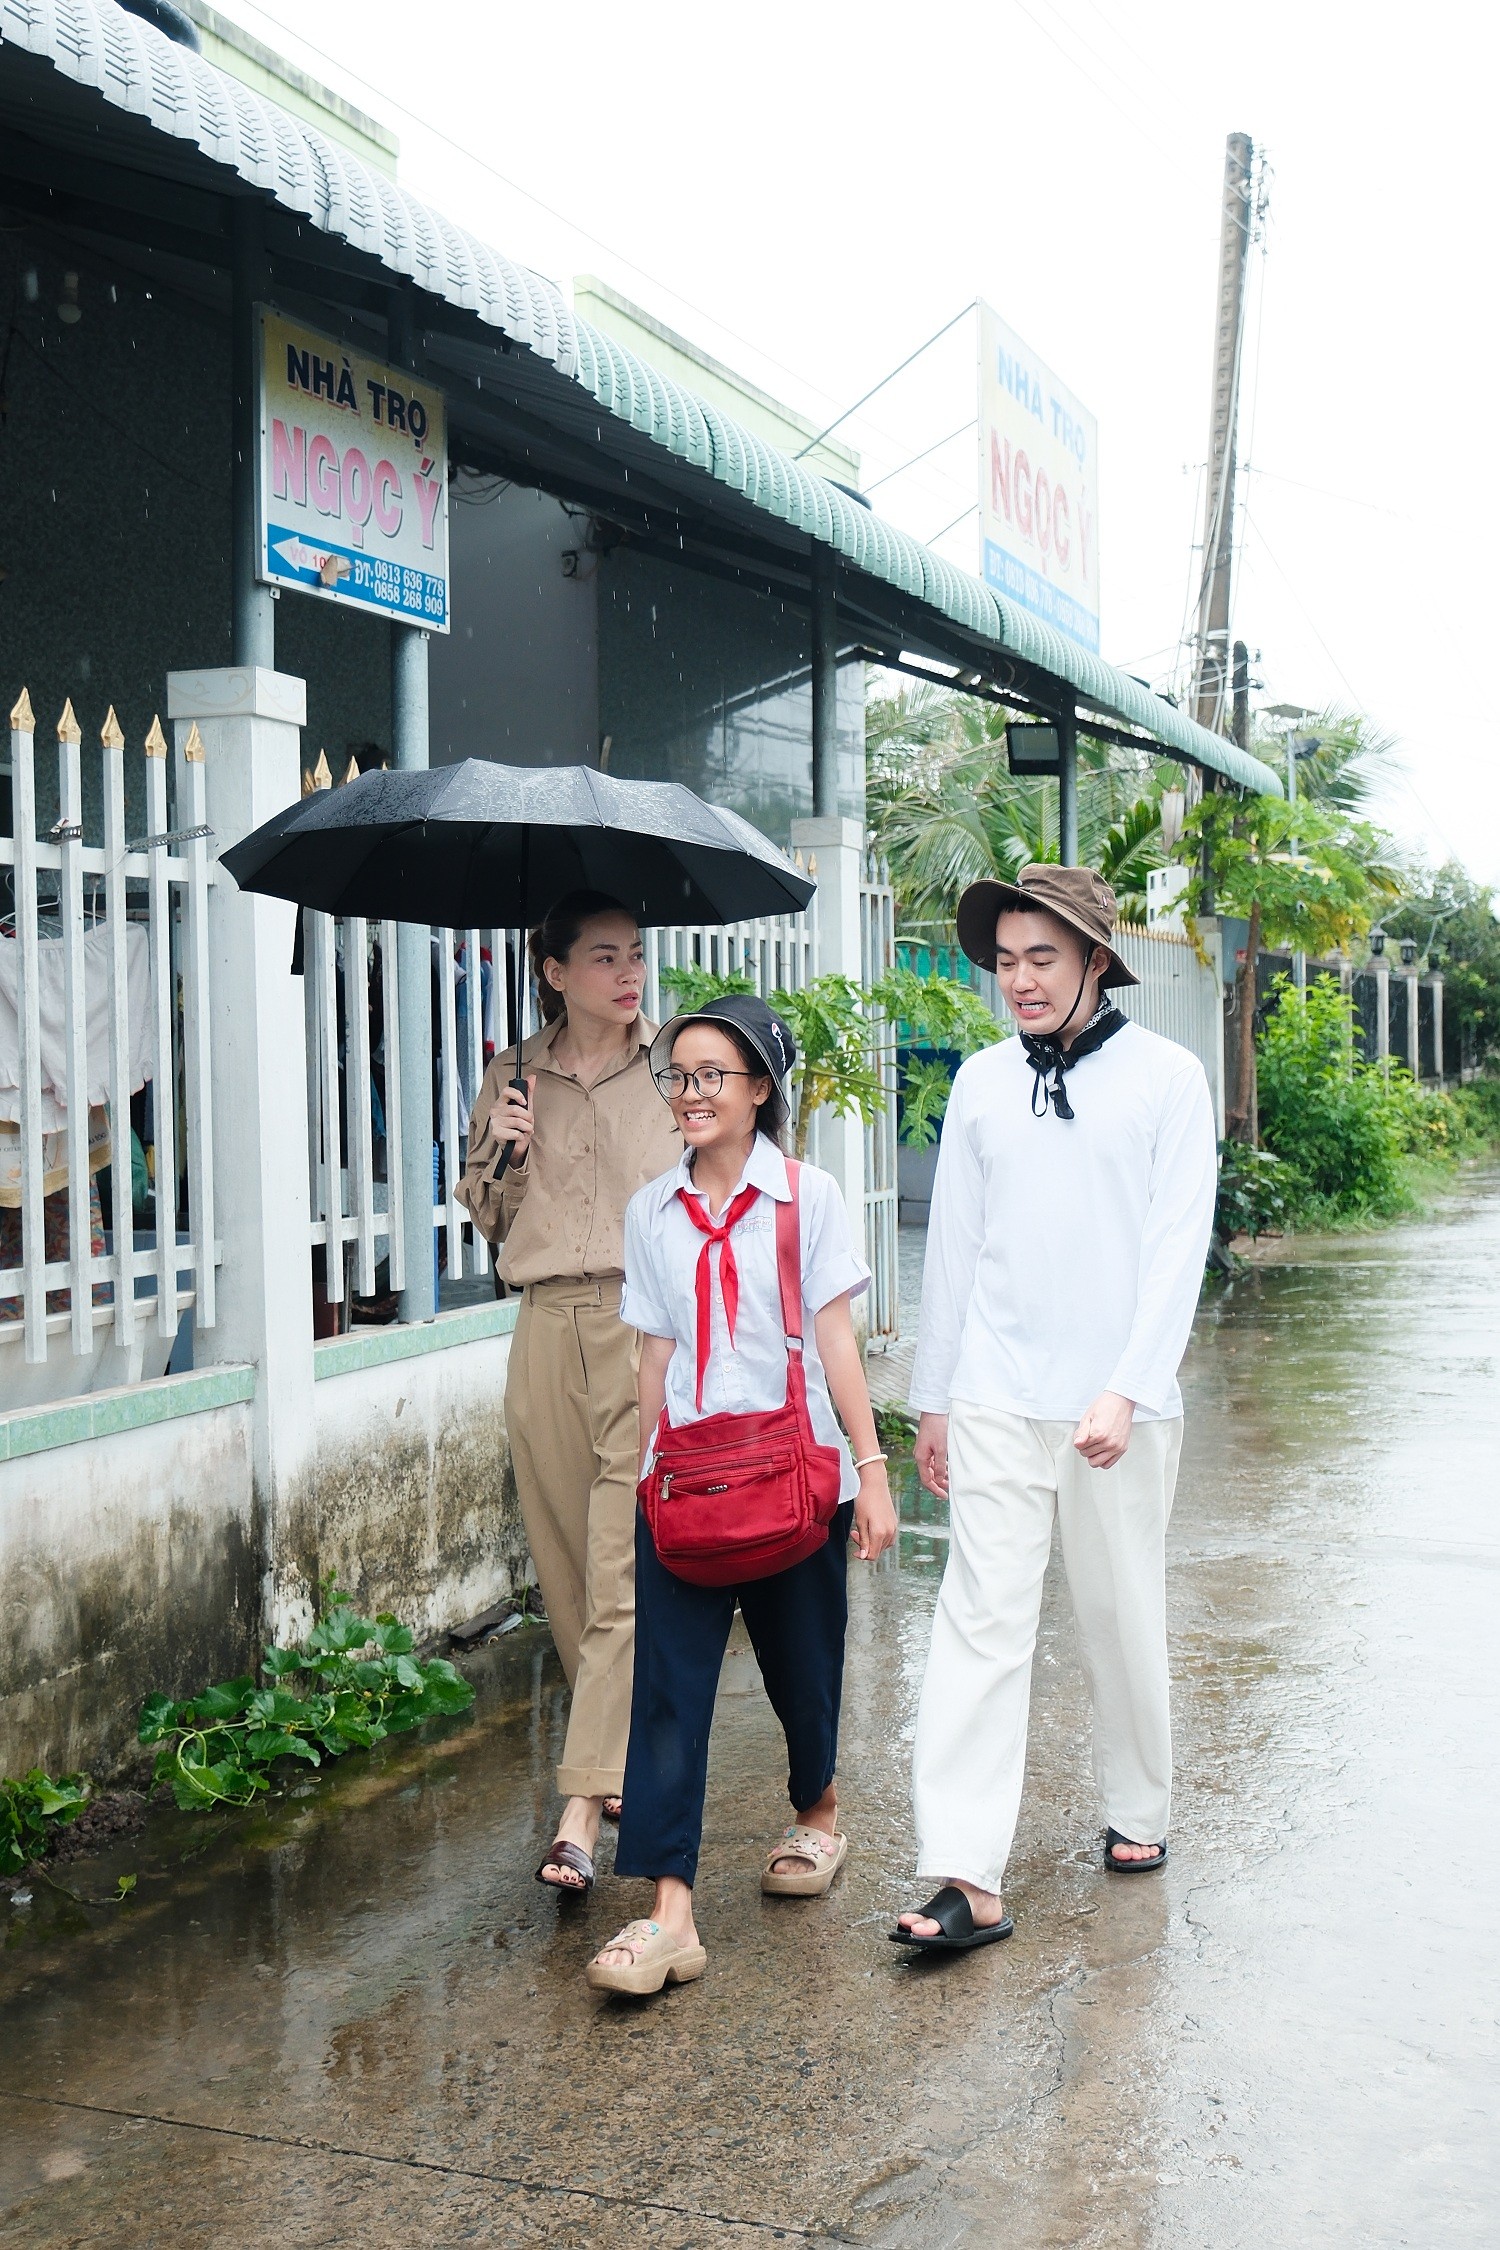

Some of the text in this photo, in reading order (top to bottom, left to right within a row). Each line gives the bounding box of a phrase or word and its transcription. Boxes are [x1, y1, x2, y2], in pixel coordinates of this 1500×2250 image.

[287, 343, 428, 450] NHÀ TRỌ
[272, 418, 442, 550] NGỌC Ý
[991, 425, 1072, 576] NGỌC
[354, 559, 444, 598] ĐT: 0813 636 778
[374, 579, 443, 617] 0858 268 909
